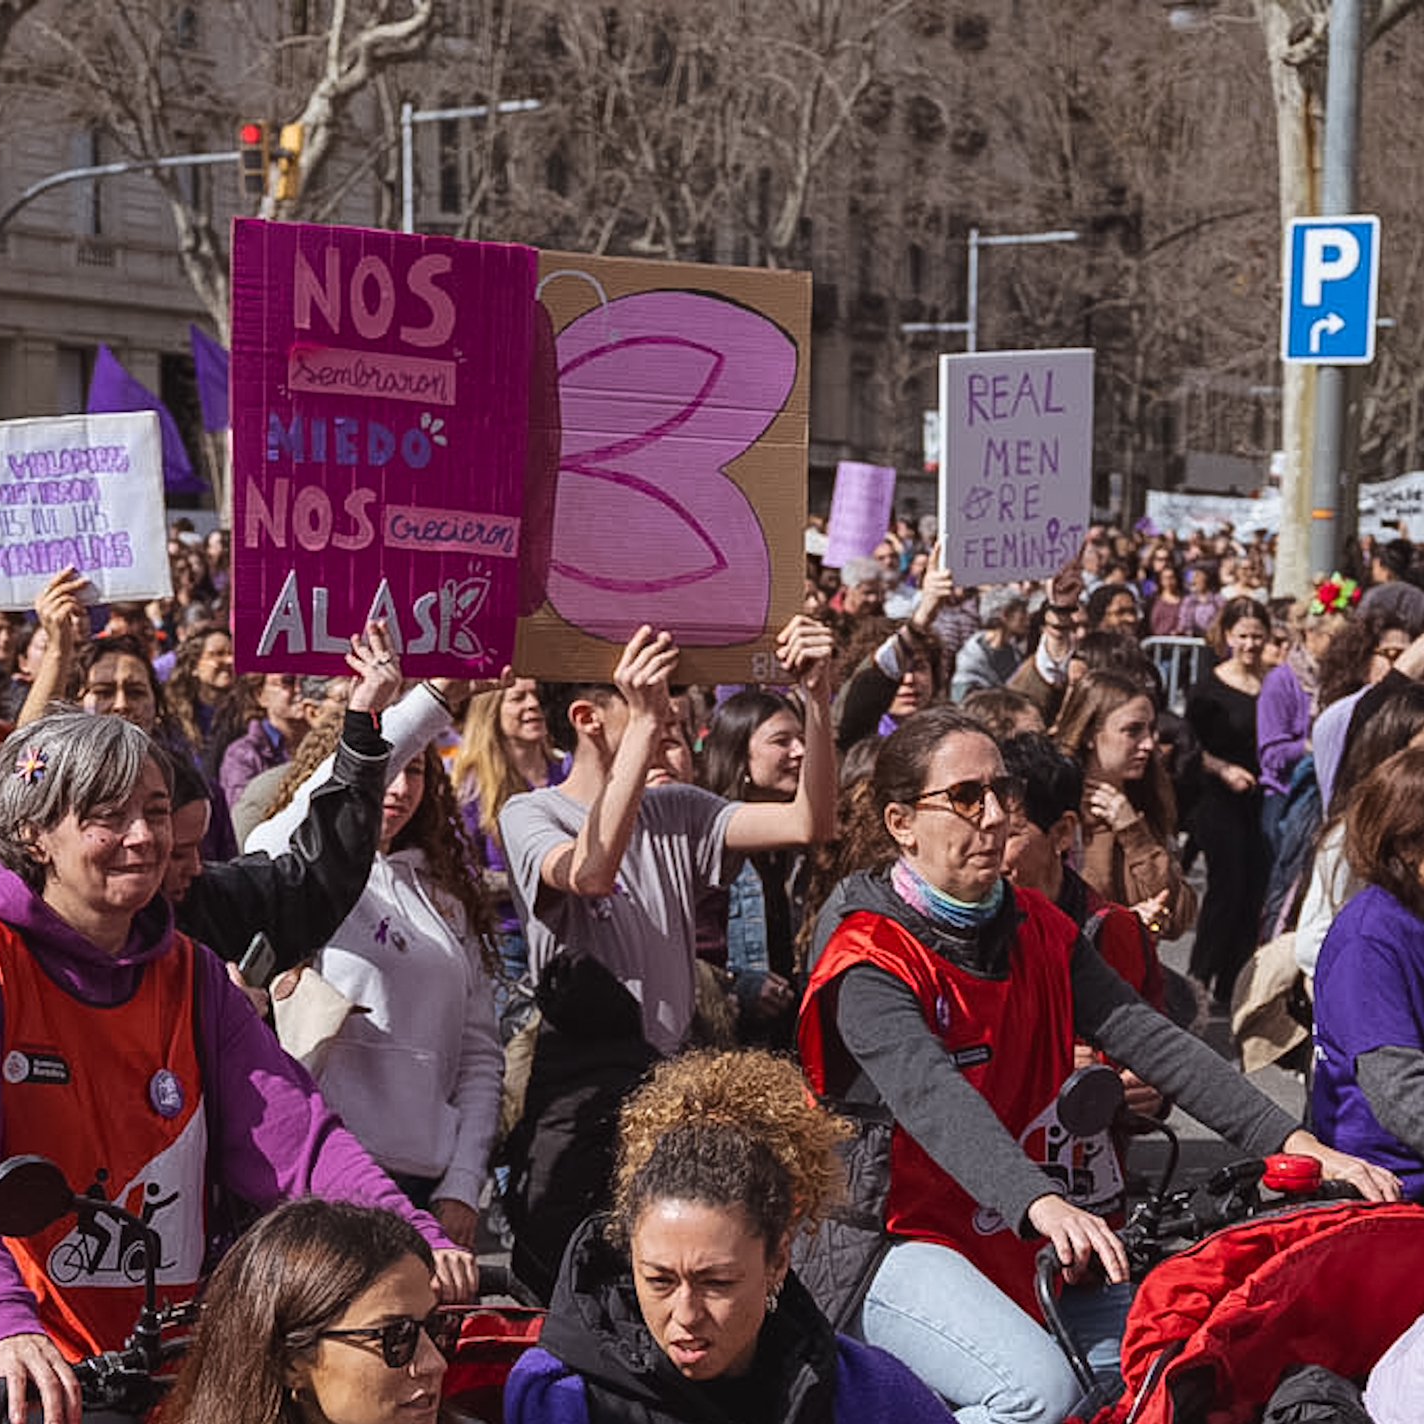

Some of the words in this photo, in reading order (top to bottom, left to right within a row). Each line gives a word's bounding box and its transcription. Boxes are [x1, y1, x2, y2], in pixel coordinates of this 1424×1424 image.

[1301, 228, 1360, 306] P
[294, 245, 456, 348] NOS
[291, 356, 449, 402] sembraron
[967, 370, 1064, 427] REAL
[266, 411, 432, 468] MIEDO
[983, 437, 1060, 478] MEN
[244, 474, 377, 552] NOS
